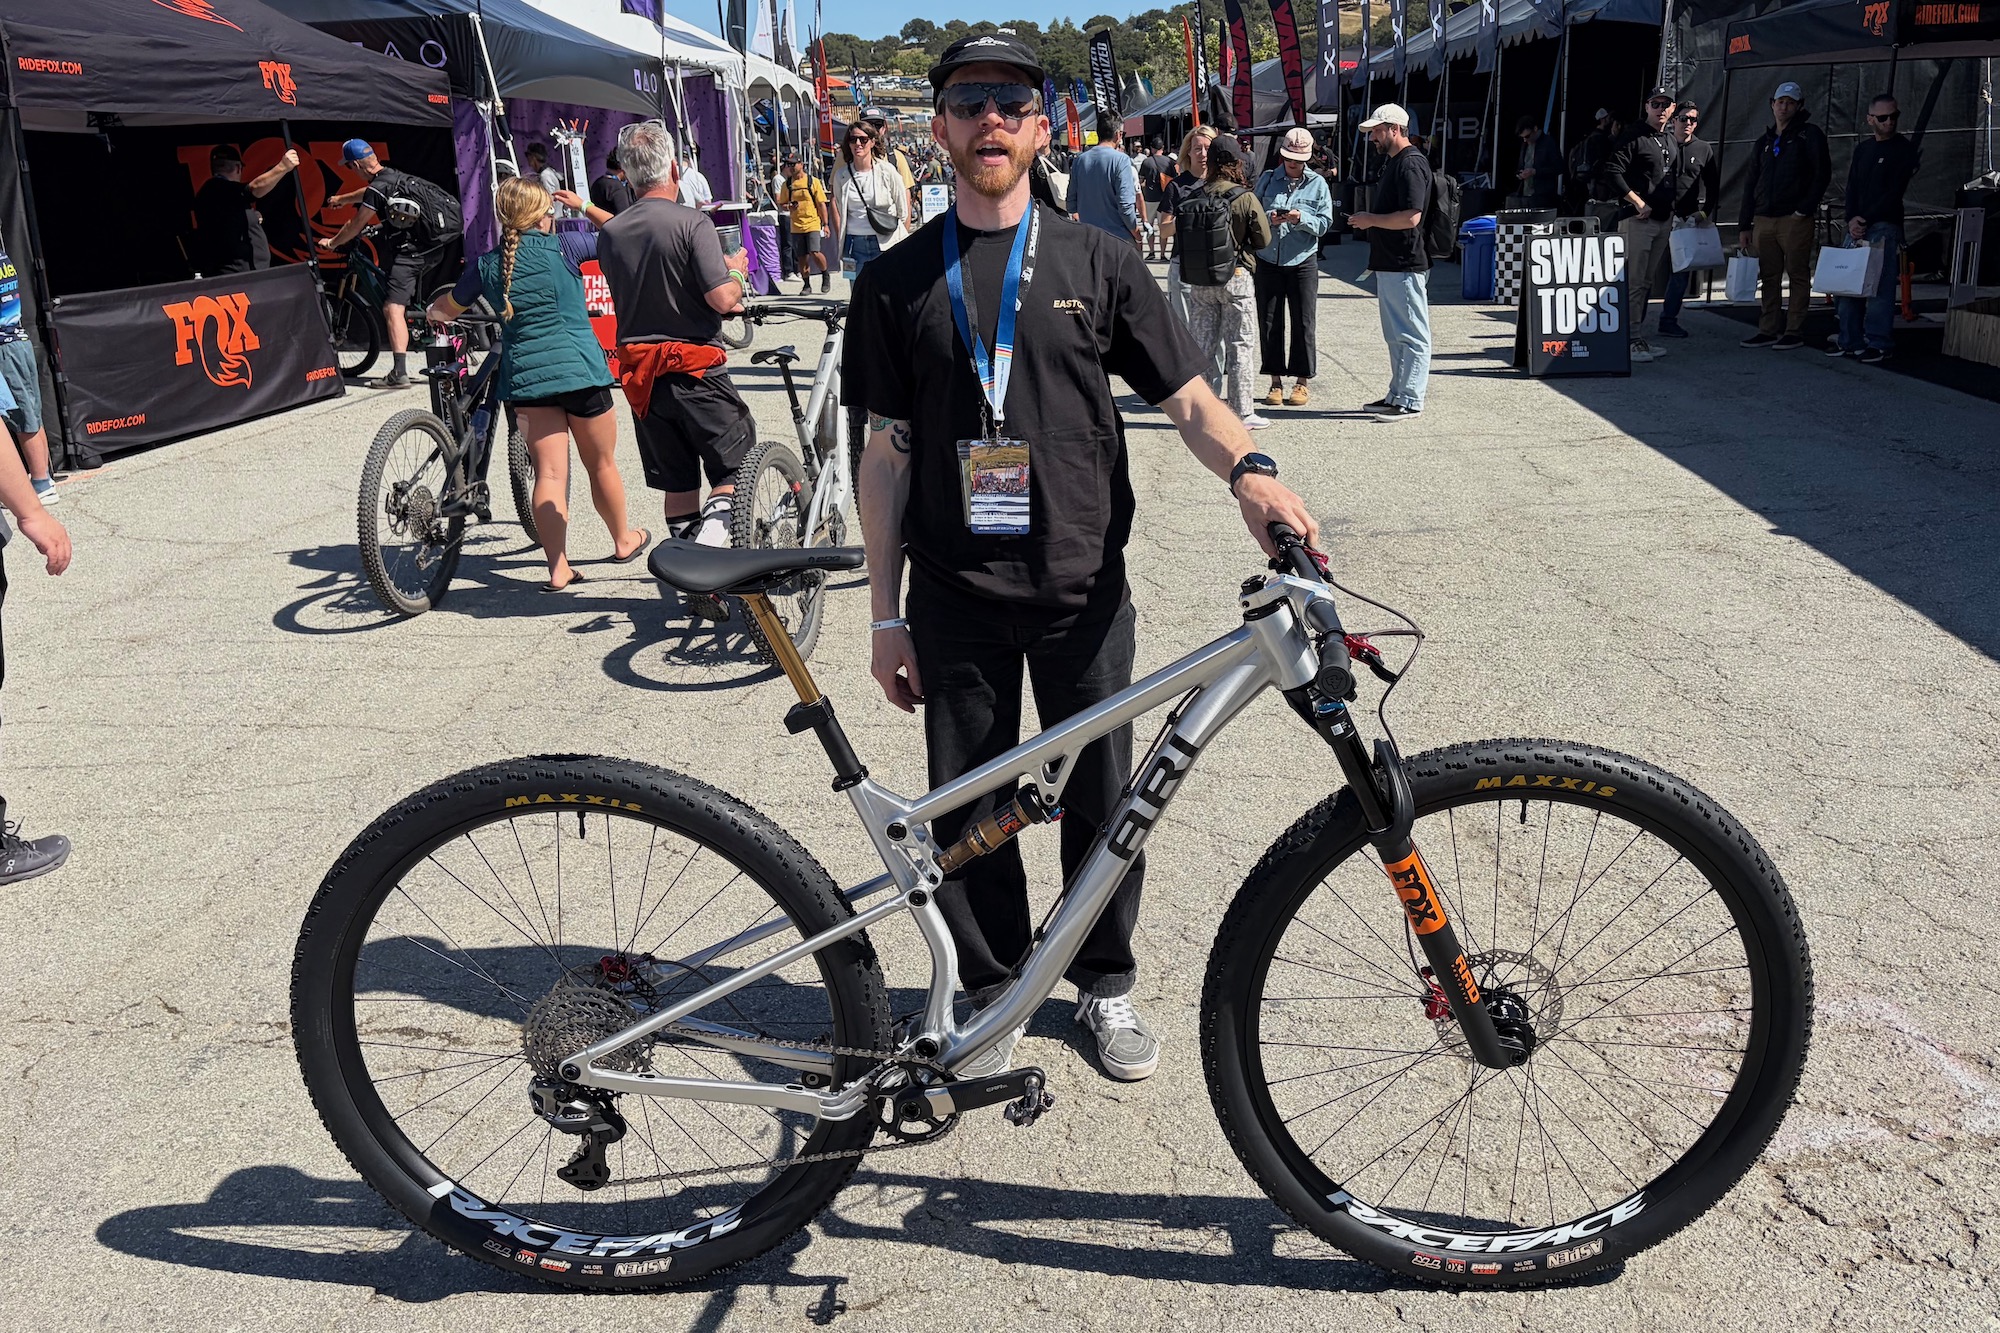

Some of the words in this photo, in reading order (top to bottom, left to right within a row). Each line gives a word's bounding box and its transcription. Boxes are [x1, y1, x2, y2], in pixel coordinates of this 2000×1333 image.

[1863, 2, 1891, 36] FOX
[1914, 3, 1981, 25] RIDEFOX.COM
[1322, 0, 1336, 77] LIX
[18, 57, 83, 75] RIDEFOX.COM
[259, 61, 297, 107] FOX
[1230, 17, 1252, 129] YAKIM
[1028, 209, 1040, 258] RACEFACE
[1530, 236, 1625, 285] SWAG
[1537, 286, 1620, 335] TOSS
[162, 292, 260, 390] FOX
[1542, 340, 1568, 357] FOX
[306, 366, 337, 382] #RIDEFOX
[86, 413, 146, 435] RIDEFOX.COM
[505, 793, 643, 812] MAXXIS
[1108, 733, 1200, 860] ARI
[1474, 775, 1618, 797] MAXXIS
[1391, 864, 1439, 927] FOX
[1455, 954, 1480, 1004] RAD
[427, 1180, 746, 1257] RACEFACE
[1326, 1190, 1648, 1253] RACEFACE
[613, 1256, 672, 1277] ASPEN
[1445, 1262, 1465, 1273] EXO
[1547, 1238, 1604, 1269] ASPEN
